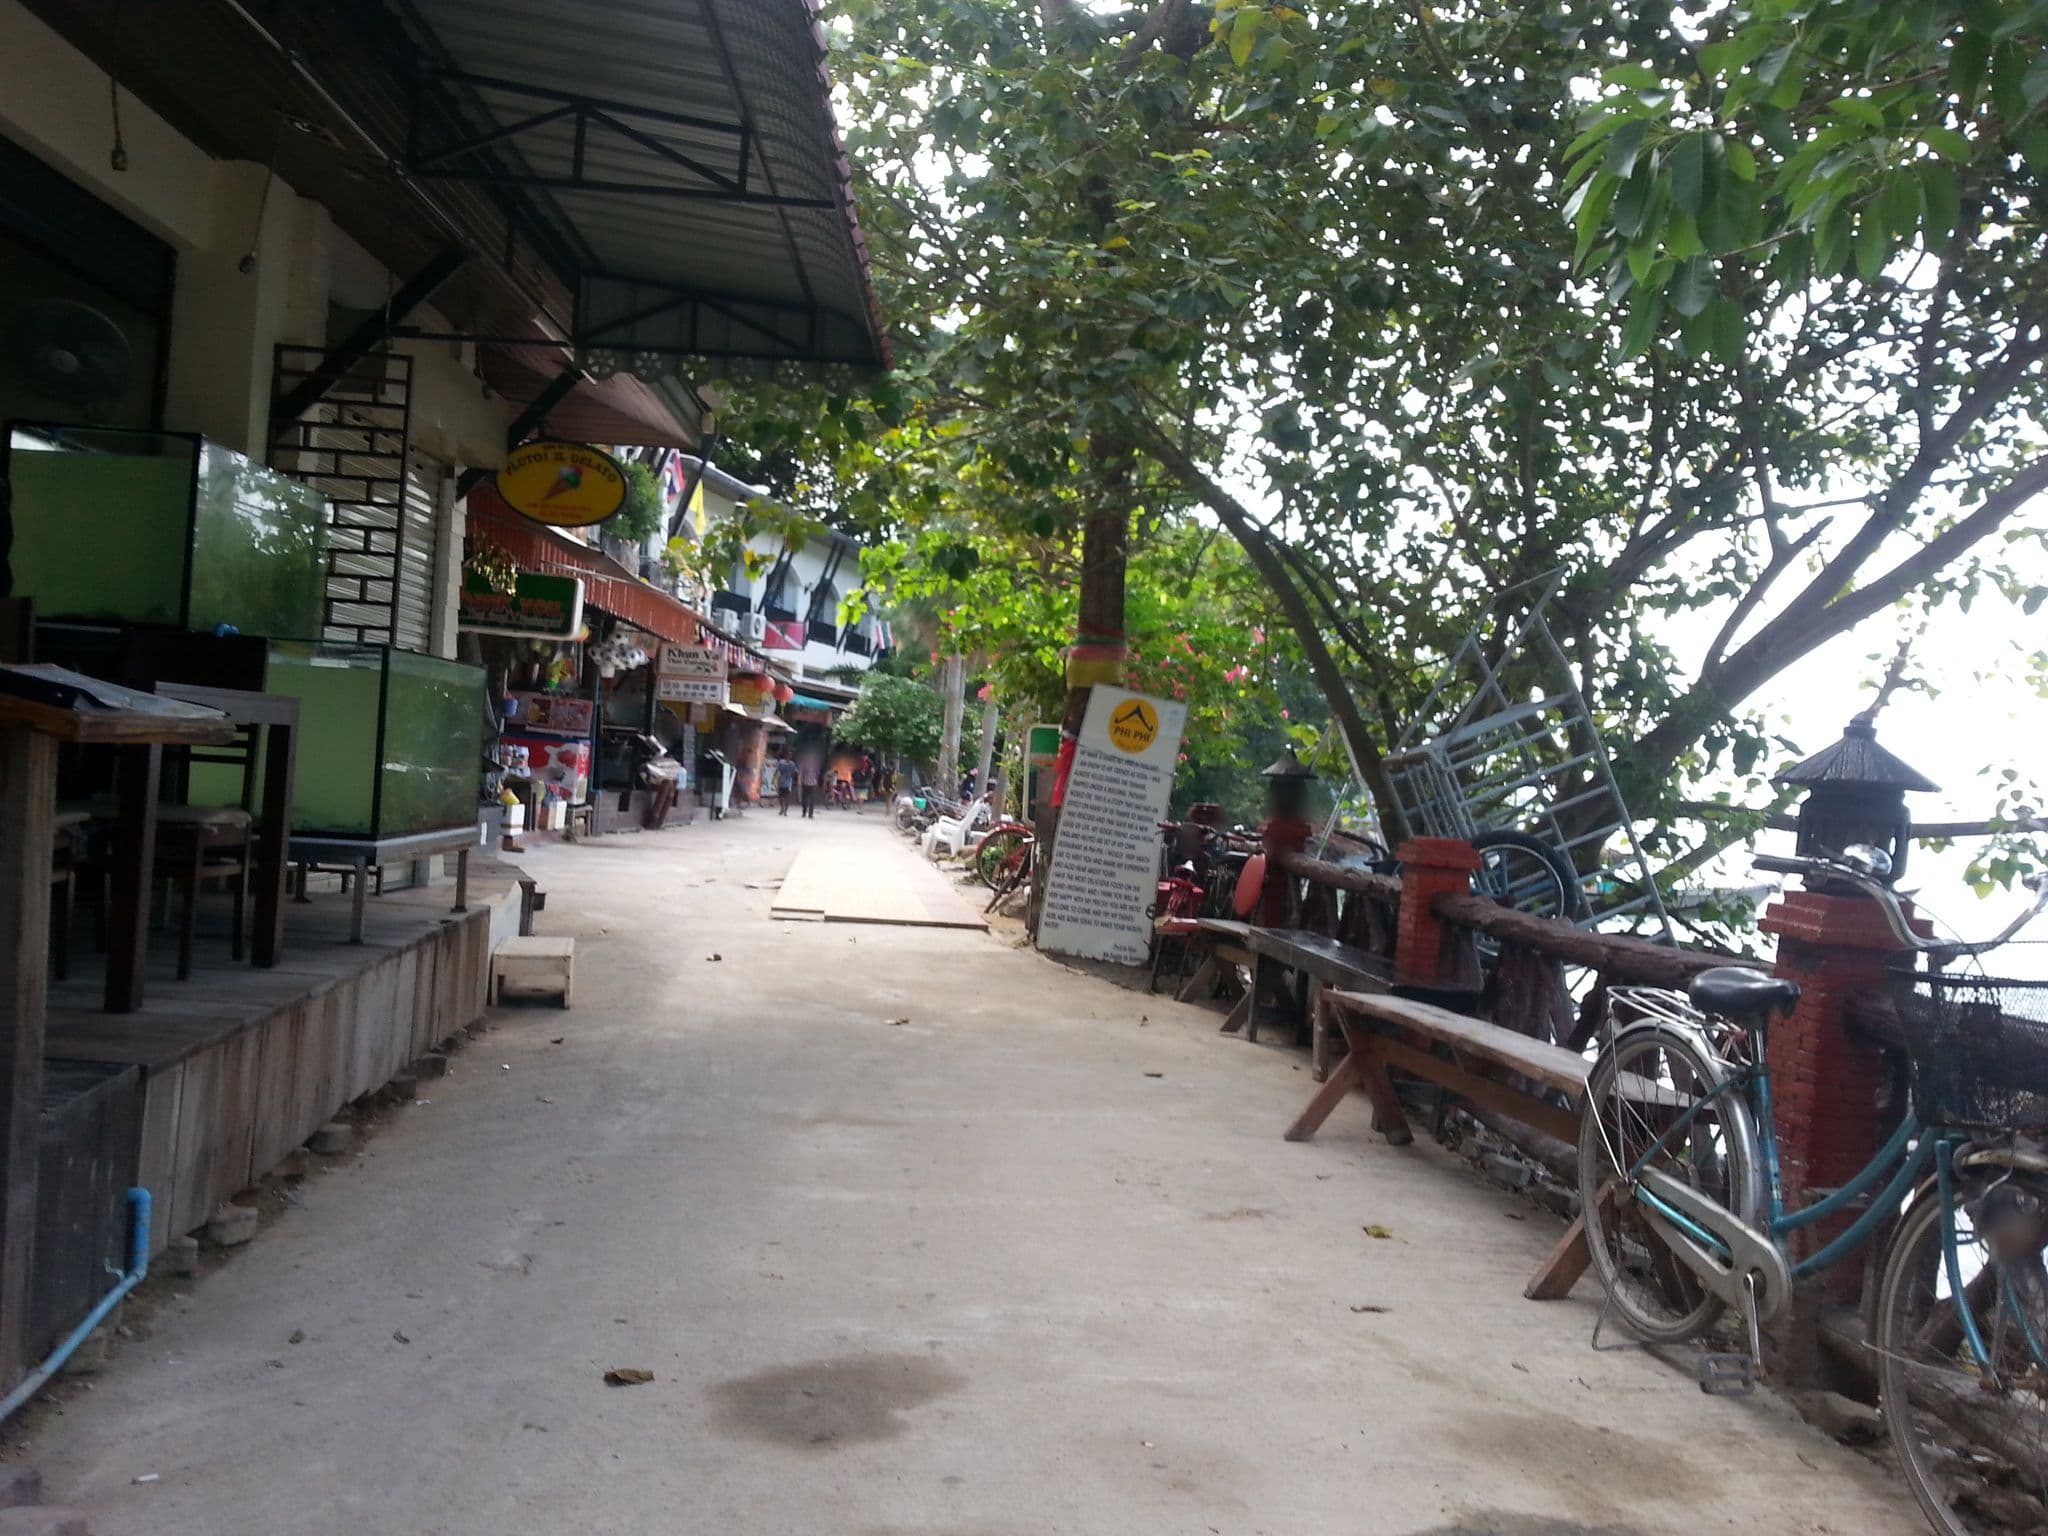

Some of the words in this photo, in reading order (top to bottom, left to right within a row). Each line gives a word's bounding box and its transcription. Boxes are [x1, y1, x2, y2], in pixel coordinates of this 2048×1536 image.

[571, 454, 617, 482] GELATO
[667, 648, 699, 658] Khun
[1114, 726, 1131, 738] PHI
[1133, 730, 1151, 742] PHI
